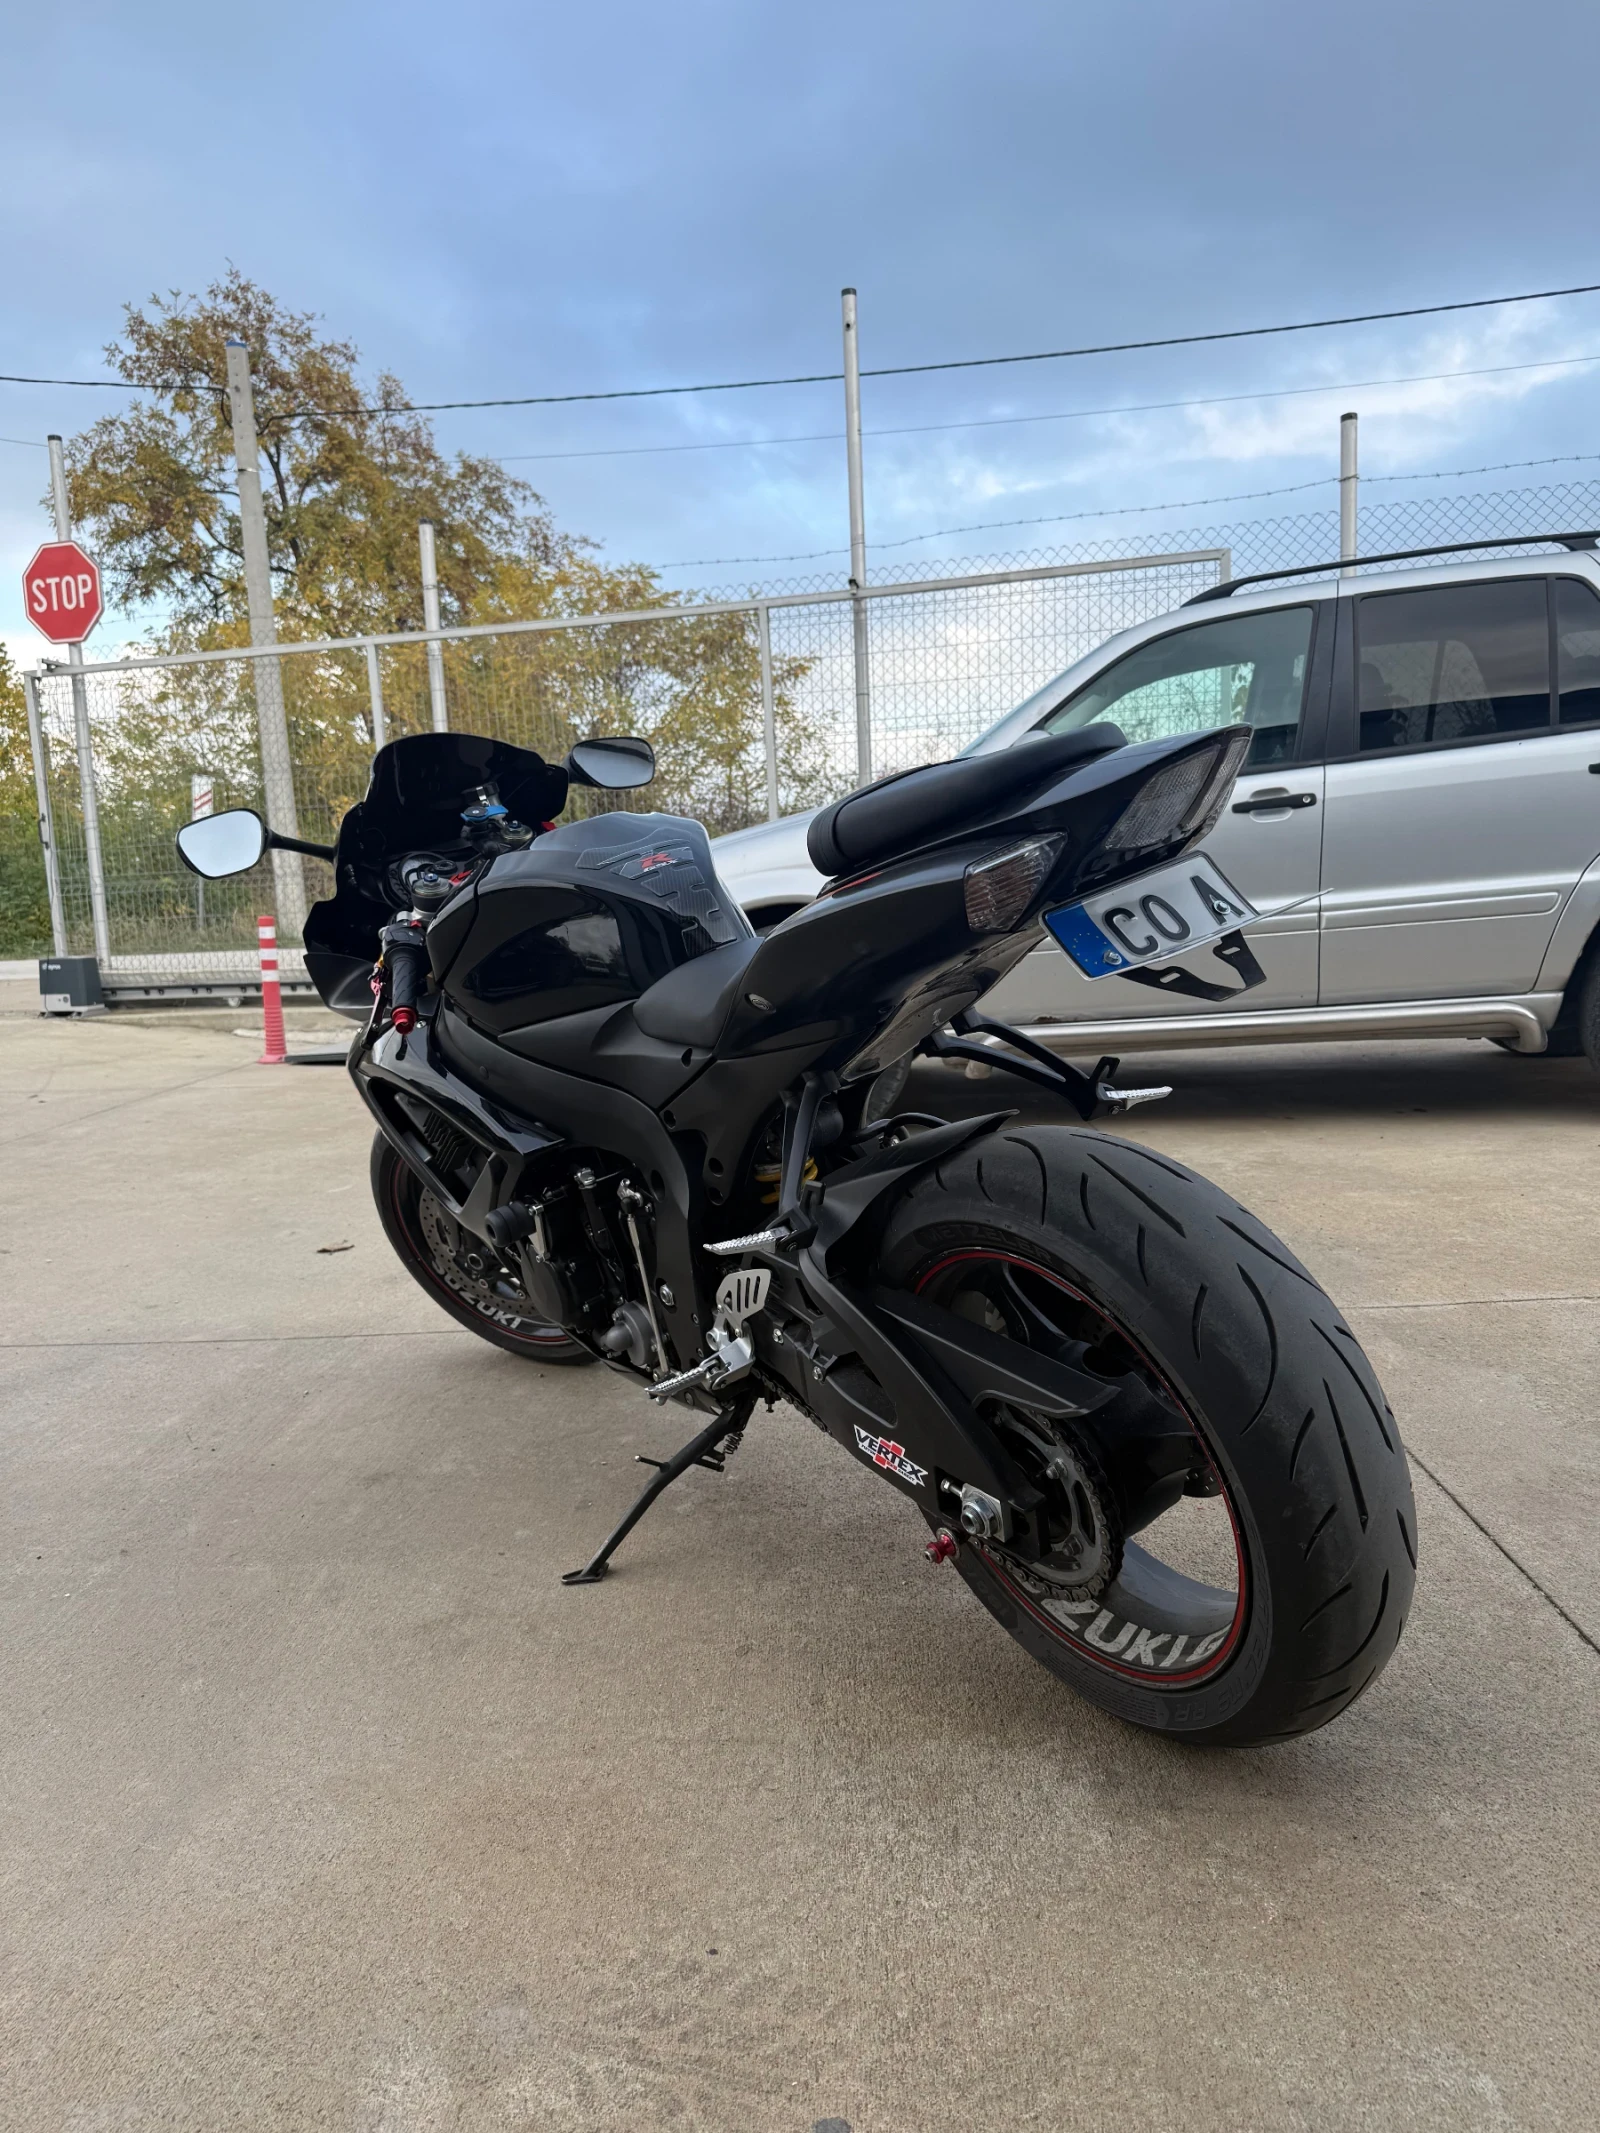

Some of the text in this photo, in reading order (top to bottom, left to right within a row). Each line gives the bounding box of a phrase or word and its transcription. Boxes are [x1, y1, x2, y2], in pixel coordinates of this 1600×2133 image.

[31, 573, 93, 614] STOP
[1102, 875, 1246, 957] CO A
[924, 1223, 1053, 1263] METZELER
[854, 1426, 924, 1483] VERTEX
